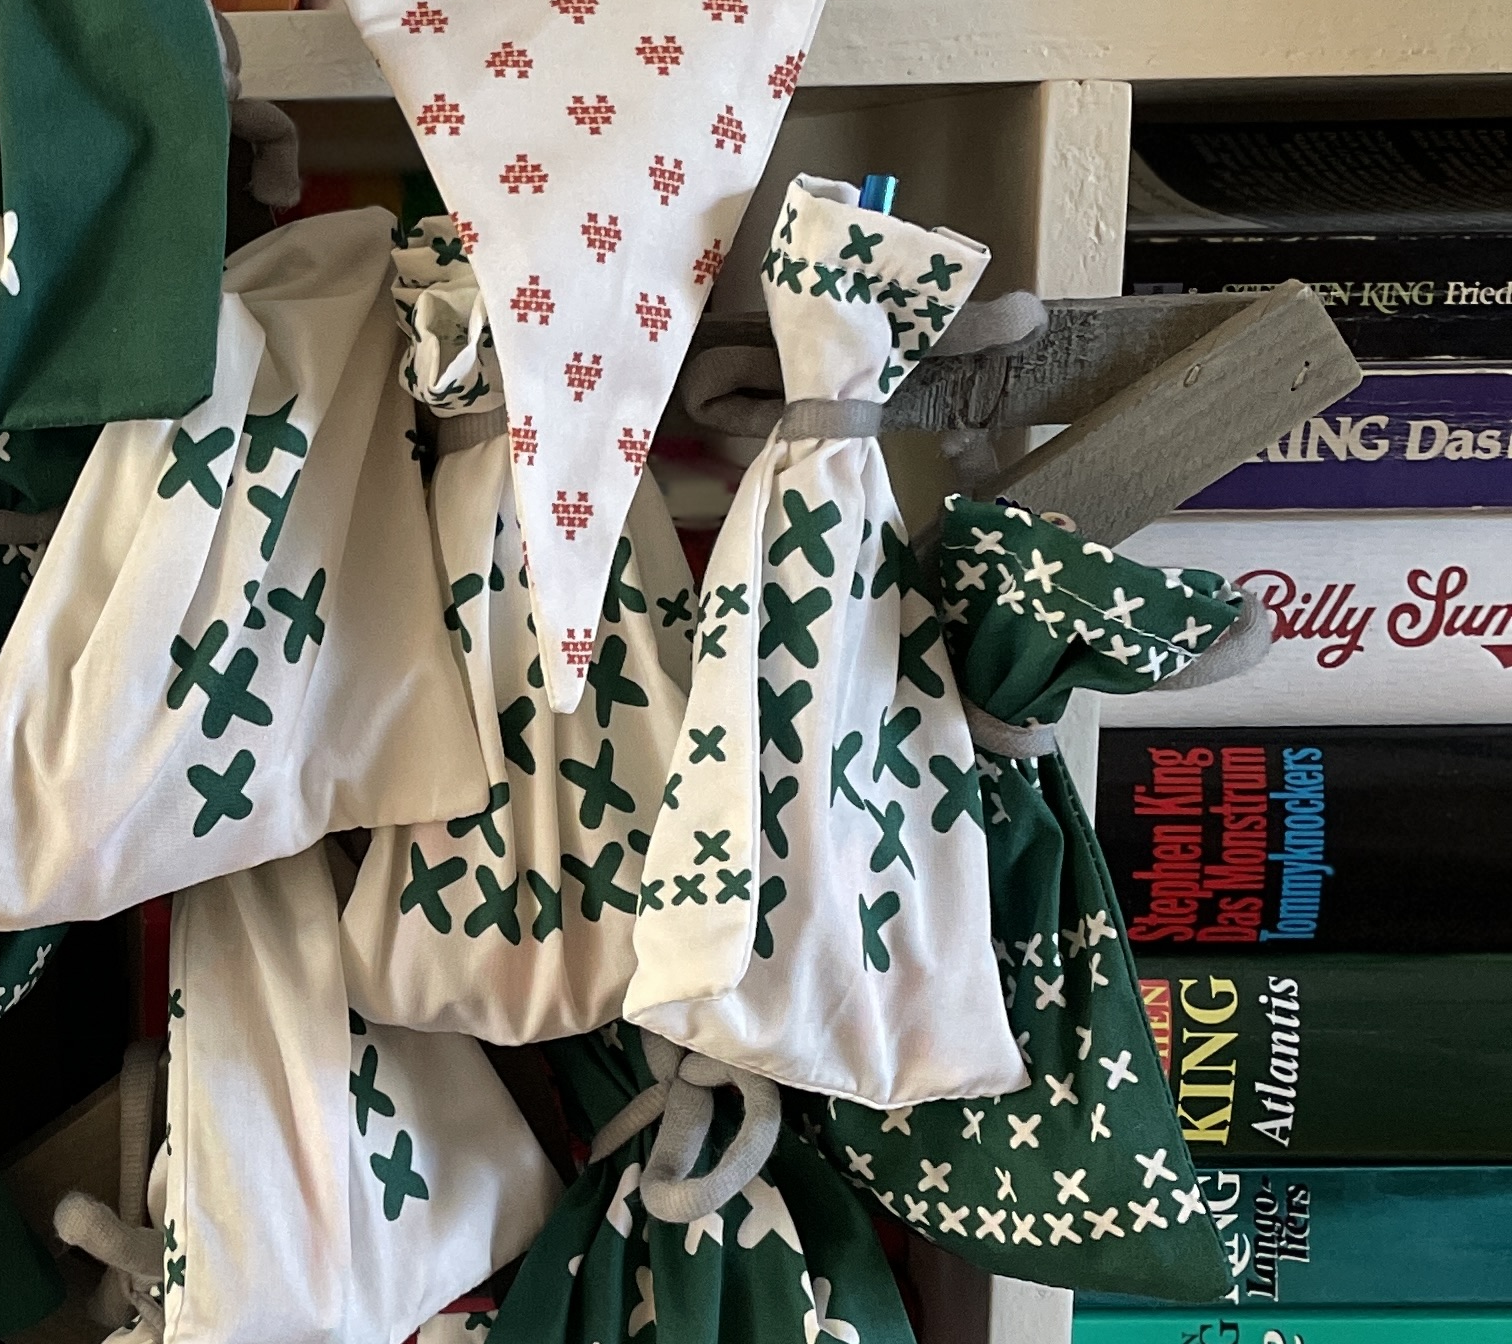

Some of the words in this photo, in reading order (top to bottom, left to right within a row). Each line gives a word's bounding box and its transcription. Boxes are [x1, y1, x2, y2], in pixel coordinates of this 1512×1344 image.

[1360, 281, 1434, 314] KING
[1406, 419, 1501, 462] Das
[1236, 568, 1376, 668] Billy
[1134, 747, 1214, 815] King
[1203, 747, 1268, 889] Monstrum
[1128, 825, 1214, 942] Stephen
[1260, 747, 1335, 942] Tommyknockers
[1197, 897, 1263, 942] Das
[1177, 975, 1239, 1146] KING
[1251, 976, 1300, 1148] Atlantis
